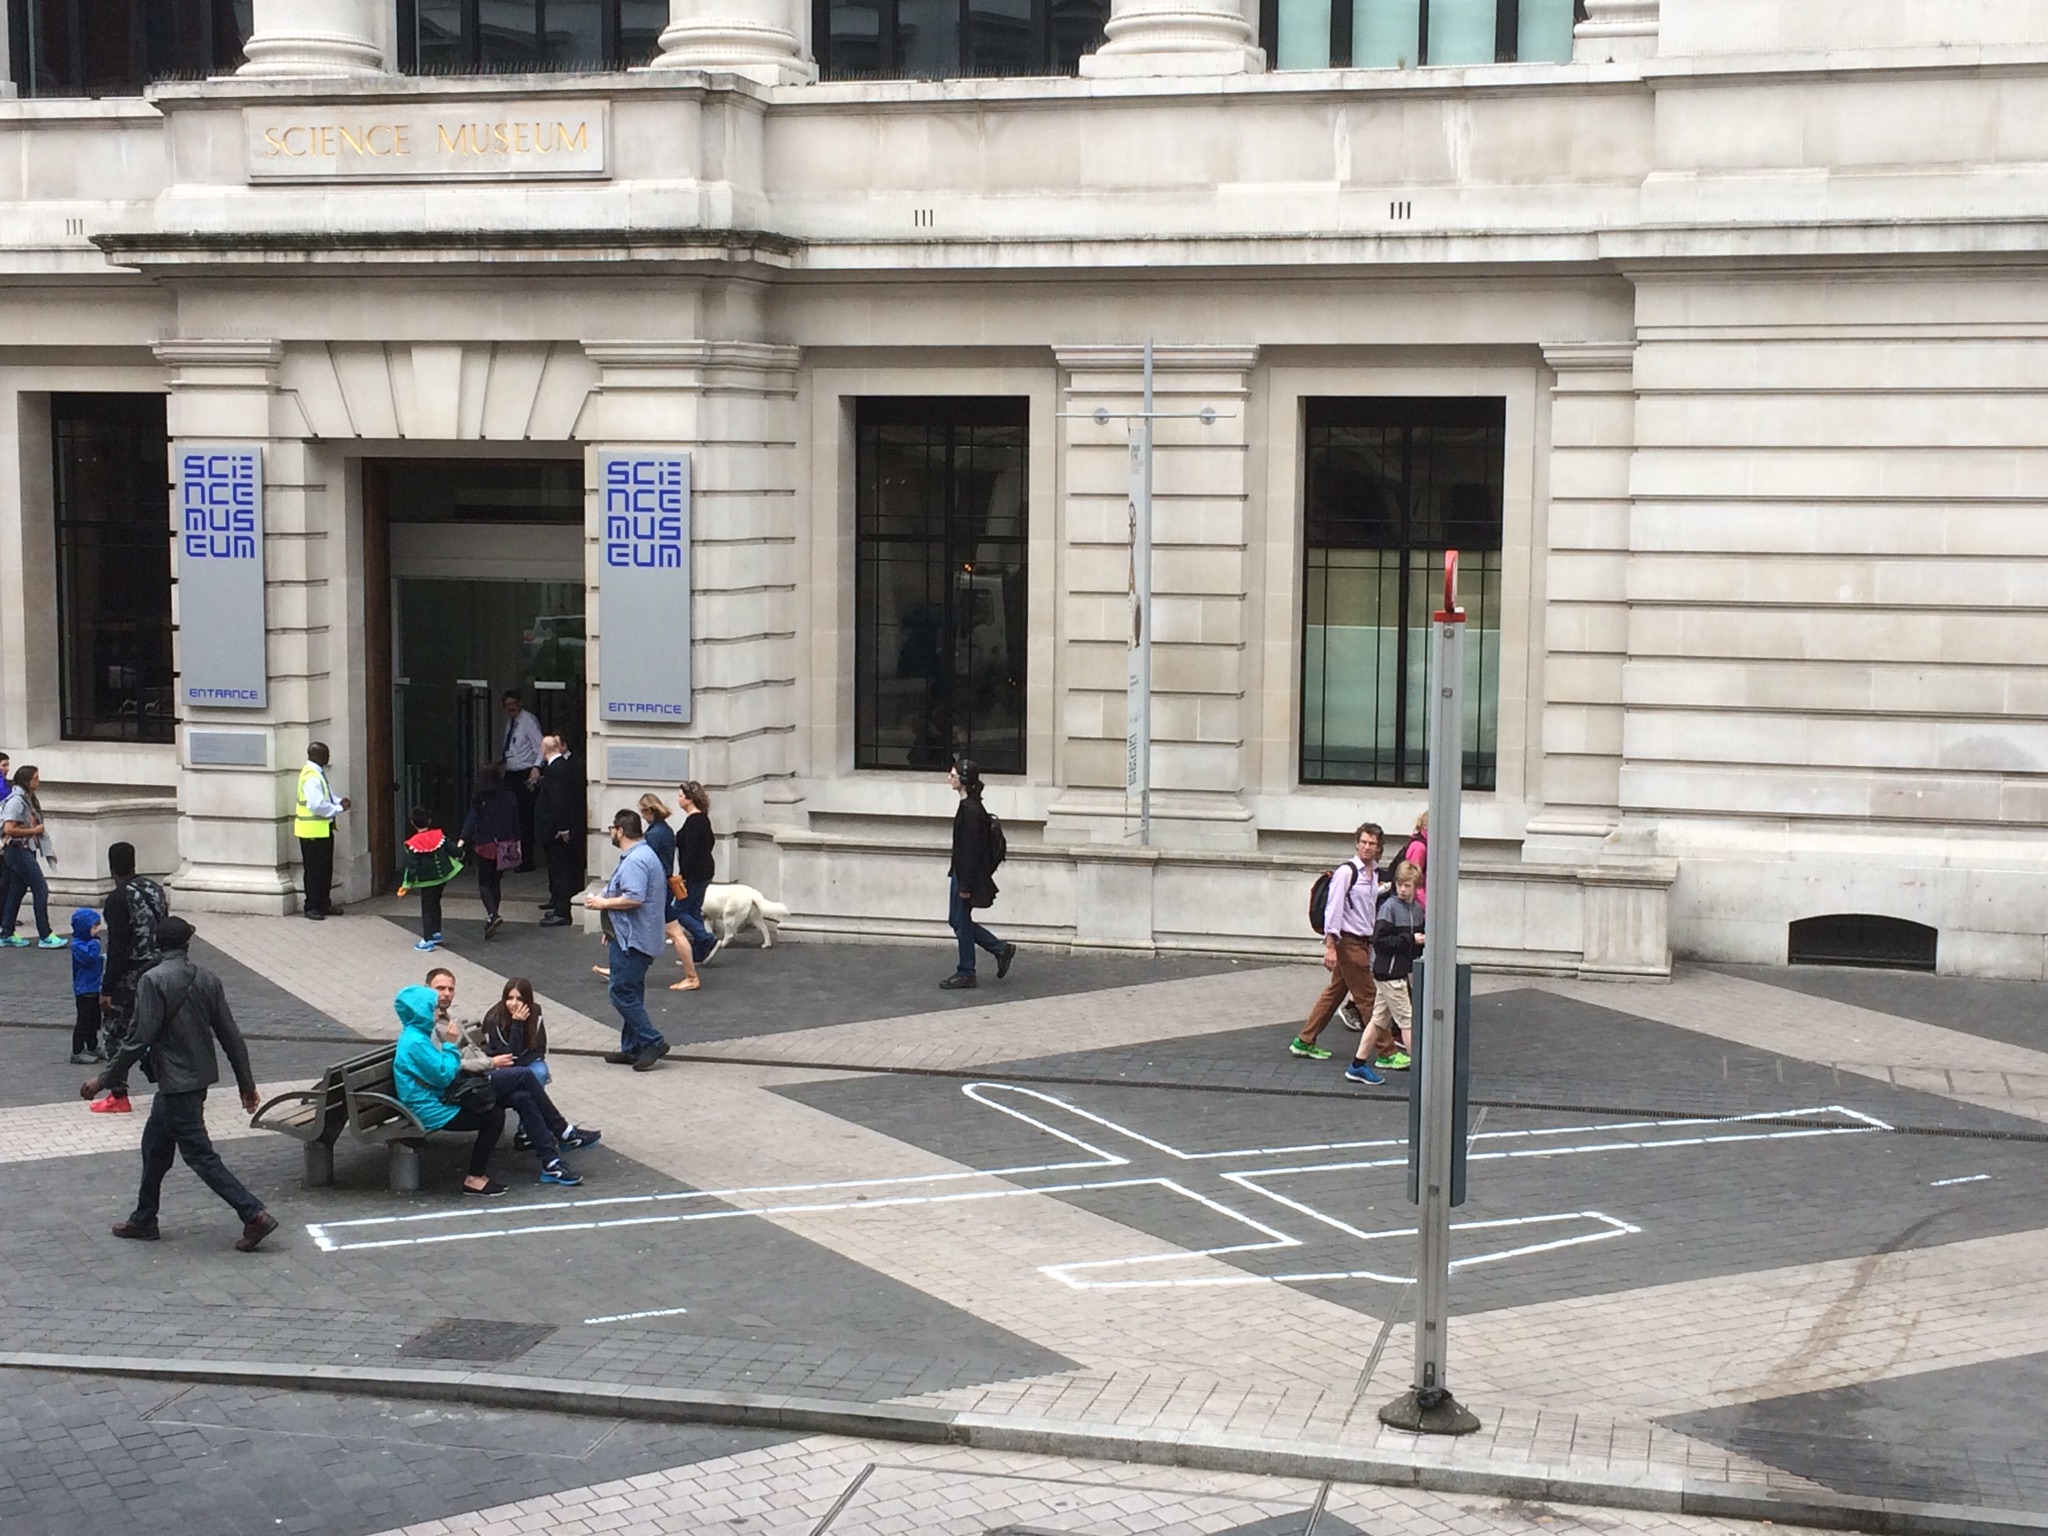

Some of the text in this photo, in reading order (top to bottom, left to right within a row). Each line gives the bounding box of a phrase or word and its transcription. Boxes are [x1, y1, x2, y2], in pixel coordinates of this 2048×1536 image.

[264, 121, 588, 157] SCIENCE MUSEUM
[189, 688, 258, 700] ENTRANCE
[608, 702, 682, 714] ENTRANCE
